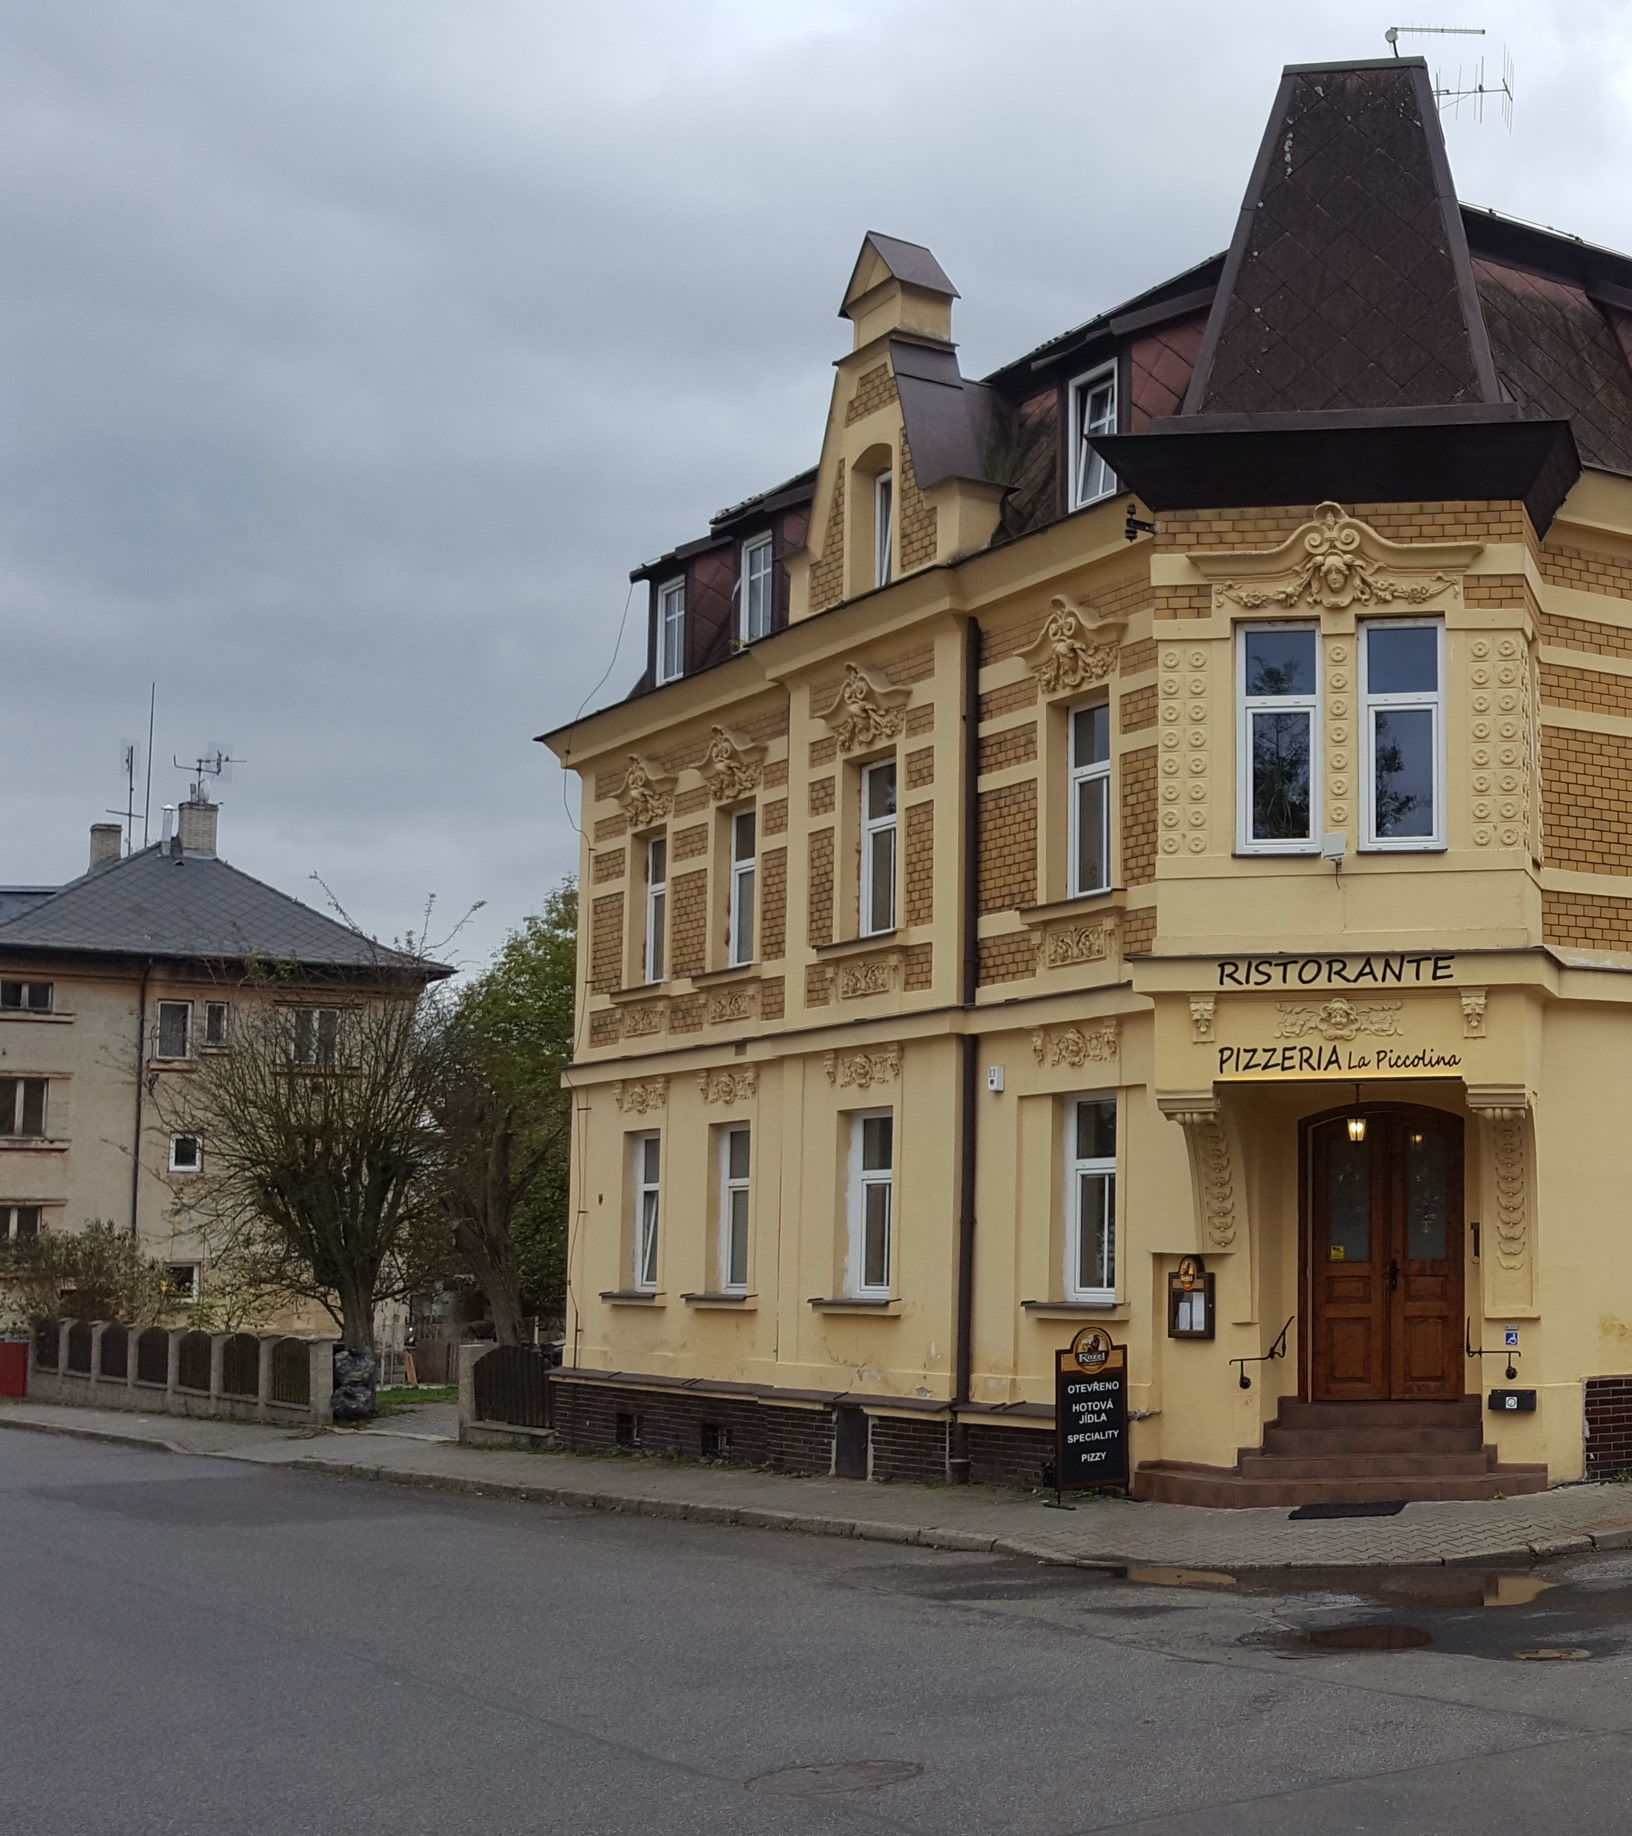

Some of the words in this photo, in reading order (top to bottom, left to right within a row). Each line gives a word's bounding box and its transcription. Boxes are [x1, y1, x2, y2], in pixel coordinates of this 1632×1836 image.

[1218, 955, 1455, 986] RISTORANTE
[1218, 1045, 1342, 1074] PIZZERIA
[1348, 1051, 1371, 1070] La
[1376, 1049, 1462, 1070] Piccolina
[1078, 1352, 1106, 1363] Kozel
[1067, 1381, 1120, 1394] OTEVŘENO
[1072, 1398, 1114, 1413] HOTOVÁ
[1078, 1412, 1107, 1424] JÍDLA
[1067, 1430, 1120, 1444] SPECIALITY
[1081, 1452, 1107, 1463] PIZZY
